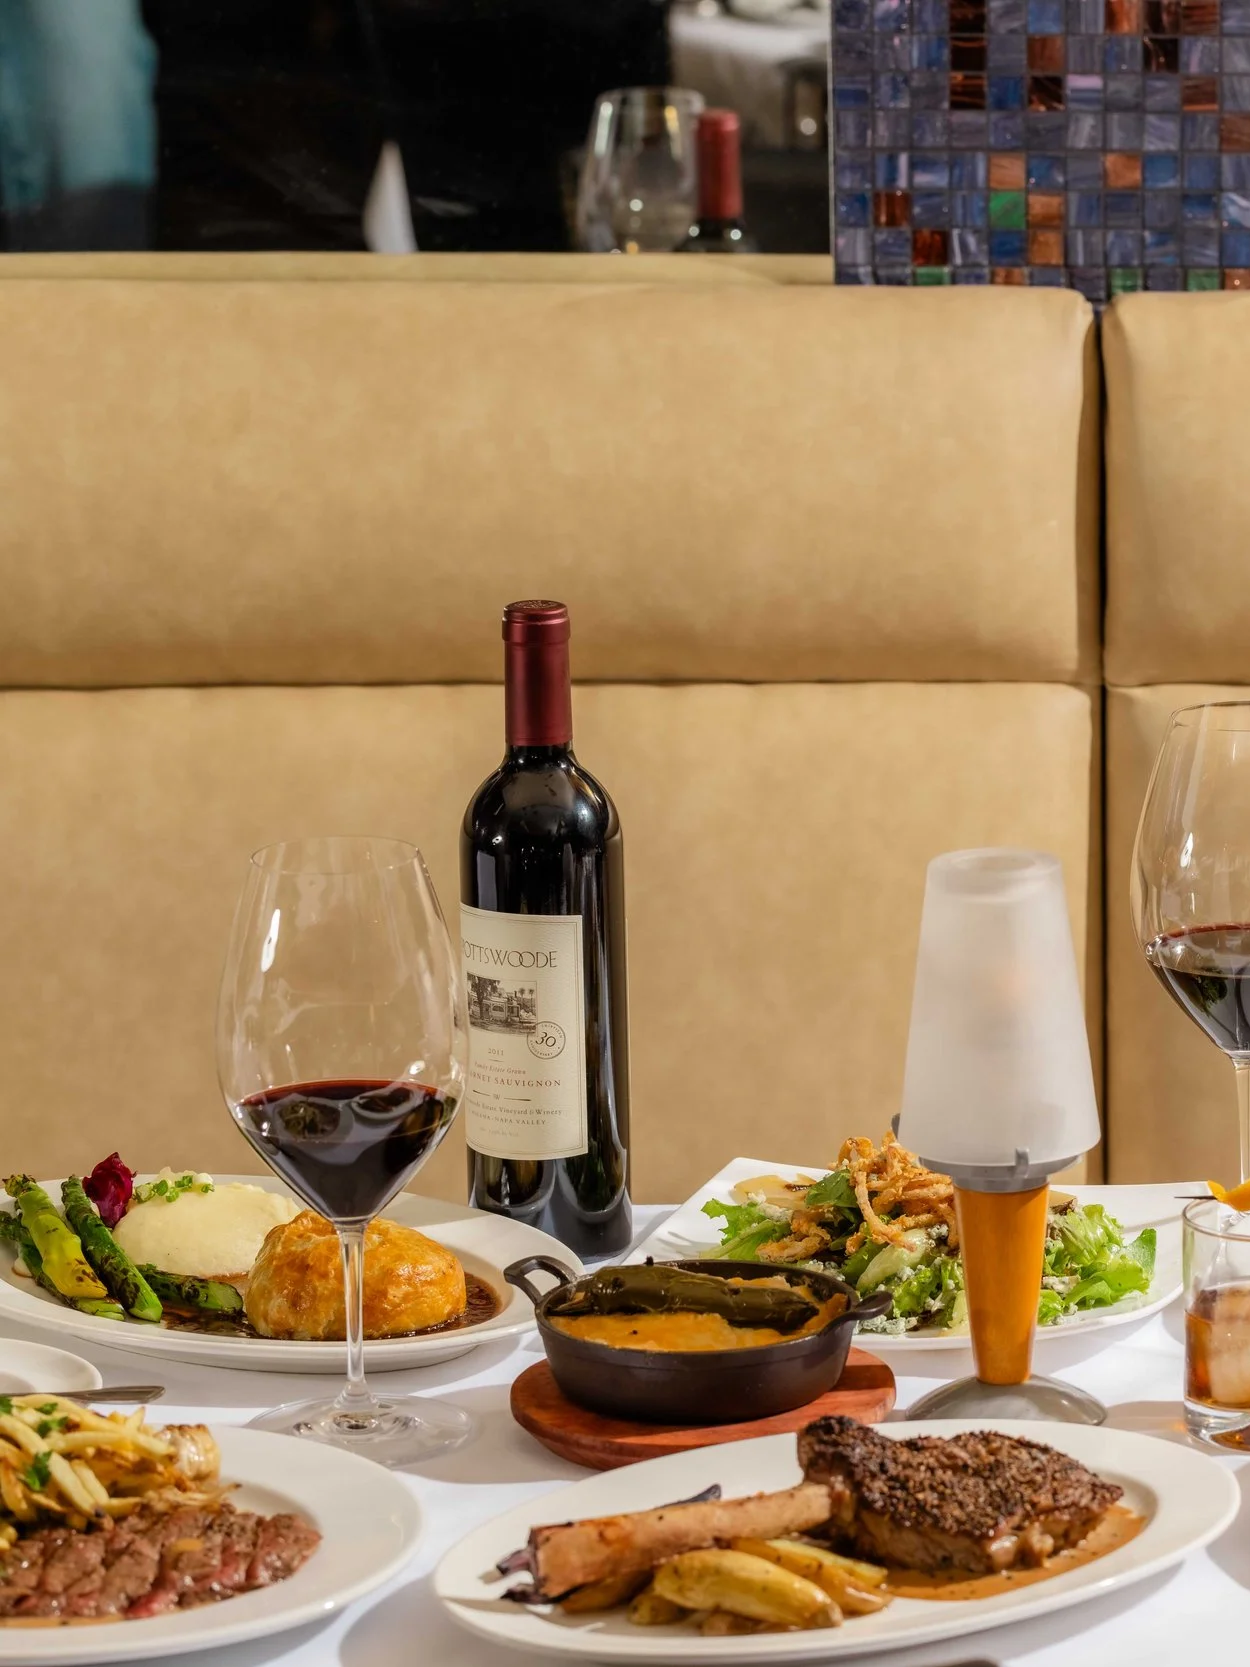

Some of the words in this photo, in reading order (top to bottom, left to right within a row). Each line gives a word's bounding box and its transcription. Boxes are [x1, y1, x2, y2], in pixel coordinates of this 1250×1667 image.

[463, 940, 558, 968] OTTSWOODE
[535, 1031, 556, 1048] 30
[494, 1077, 561, 1087] SAUVIGNON
